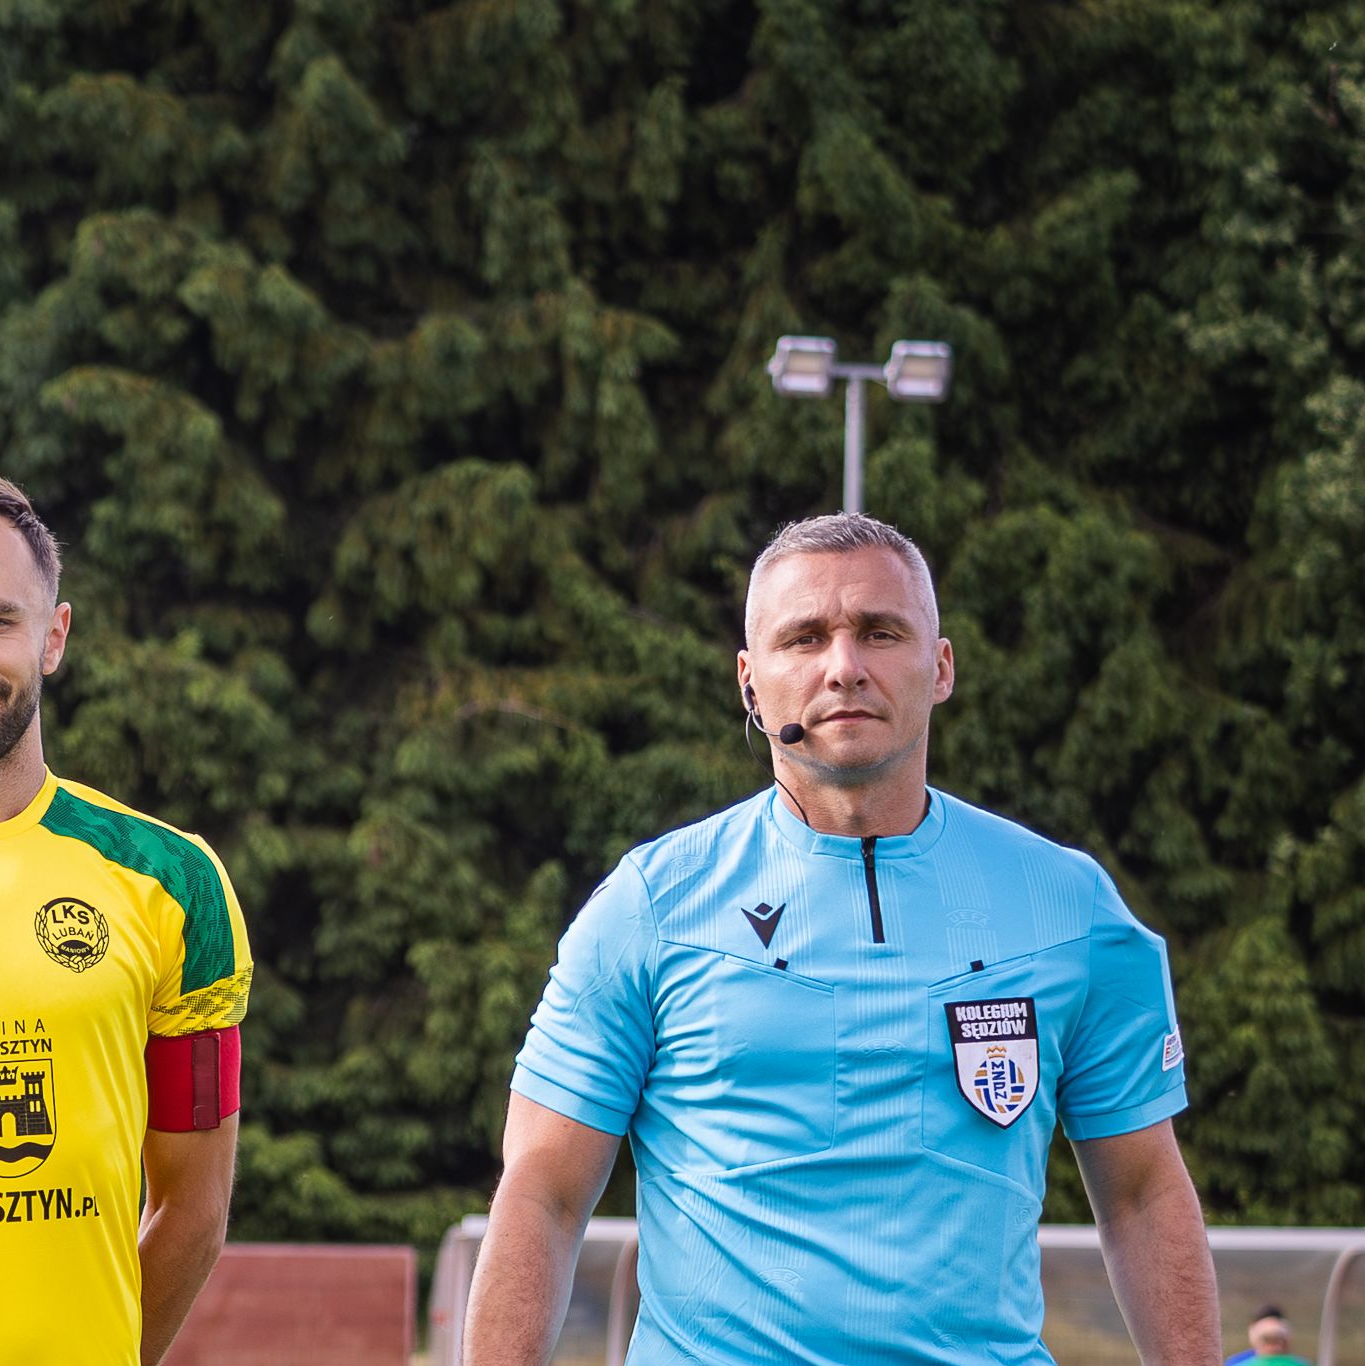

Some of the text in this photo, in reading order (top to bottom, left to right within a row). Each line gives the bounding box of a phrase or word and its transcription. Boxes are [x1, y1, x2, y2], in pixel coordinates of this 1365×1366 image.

[51, 904, 90, 925] LKS
[52, 926, 95, 941] LUBAŃ
[955, 1002, 1028, 1022] KOLEGIUM
[960, 1019, 1026, 1039] SĘDZIÓW
